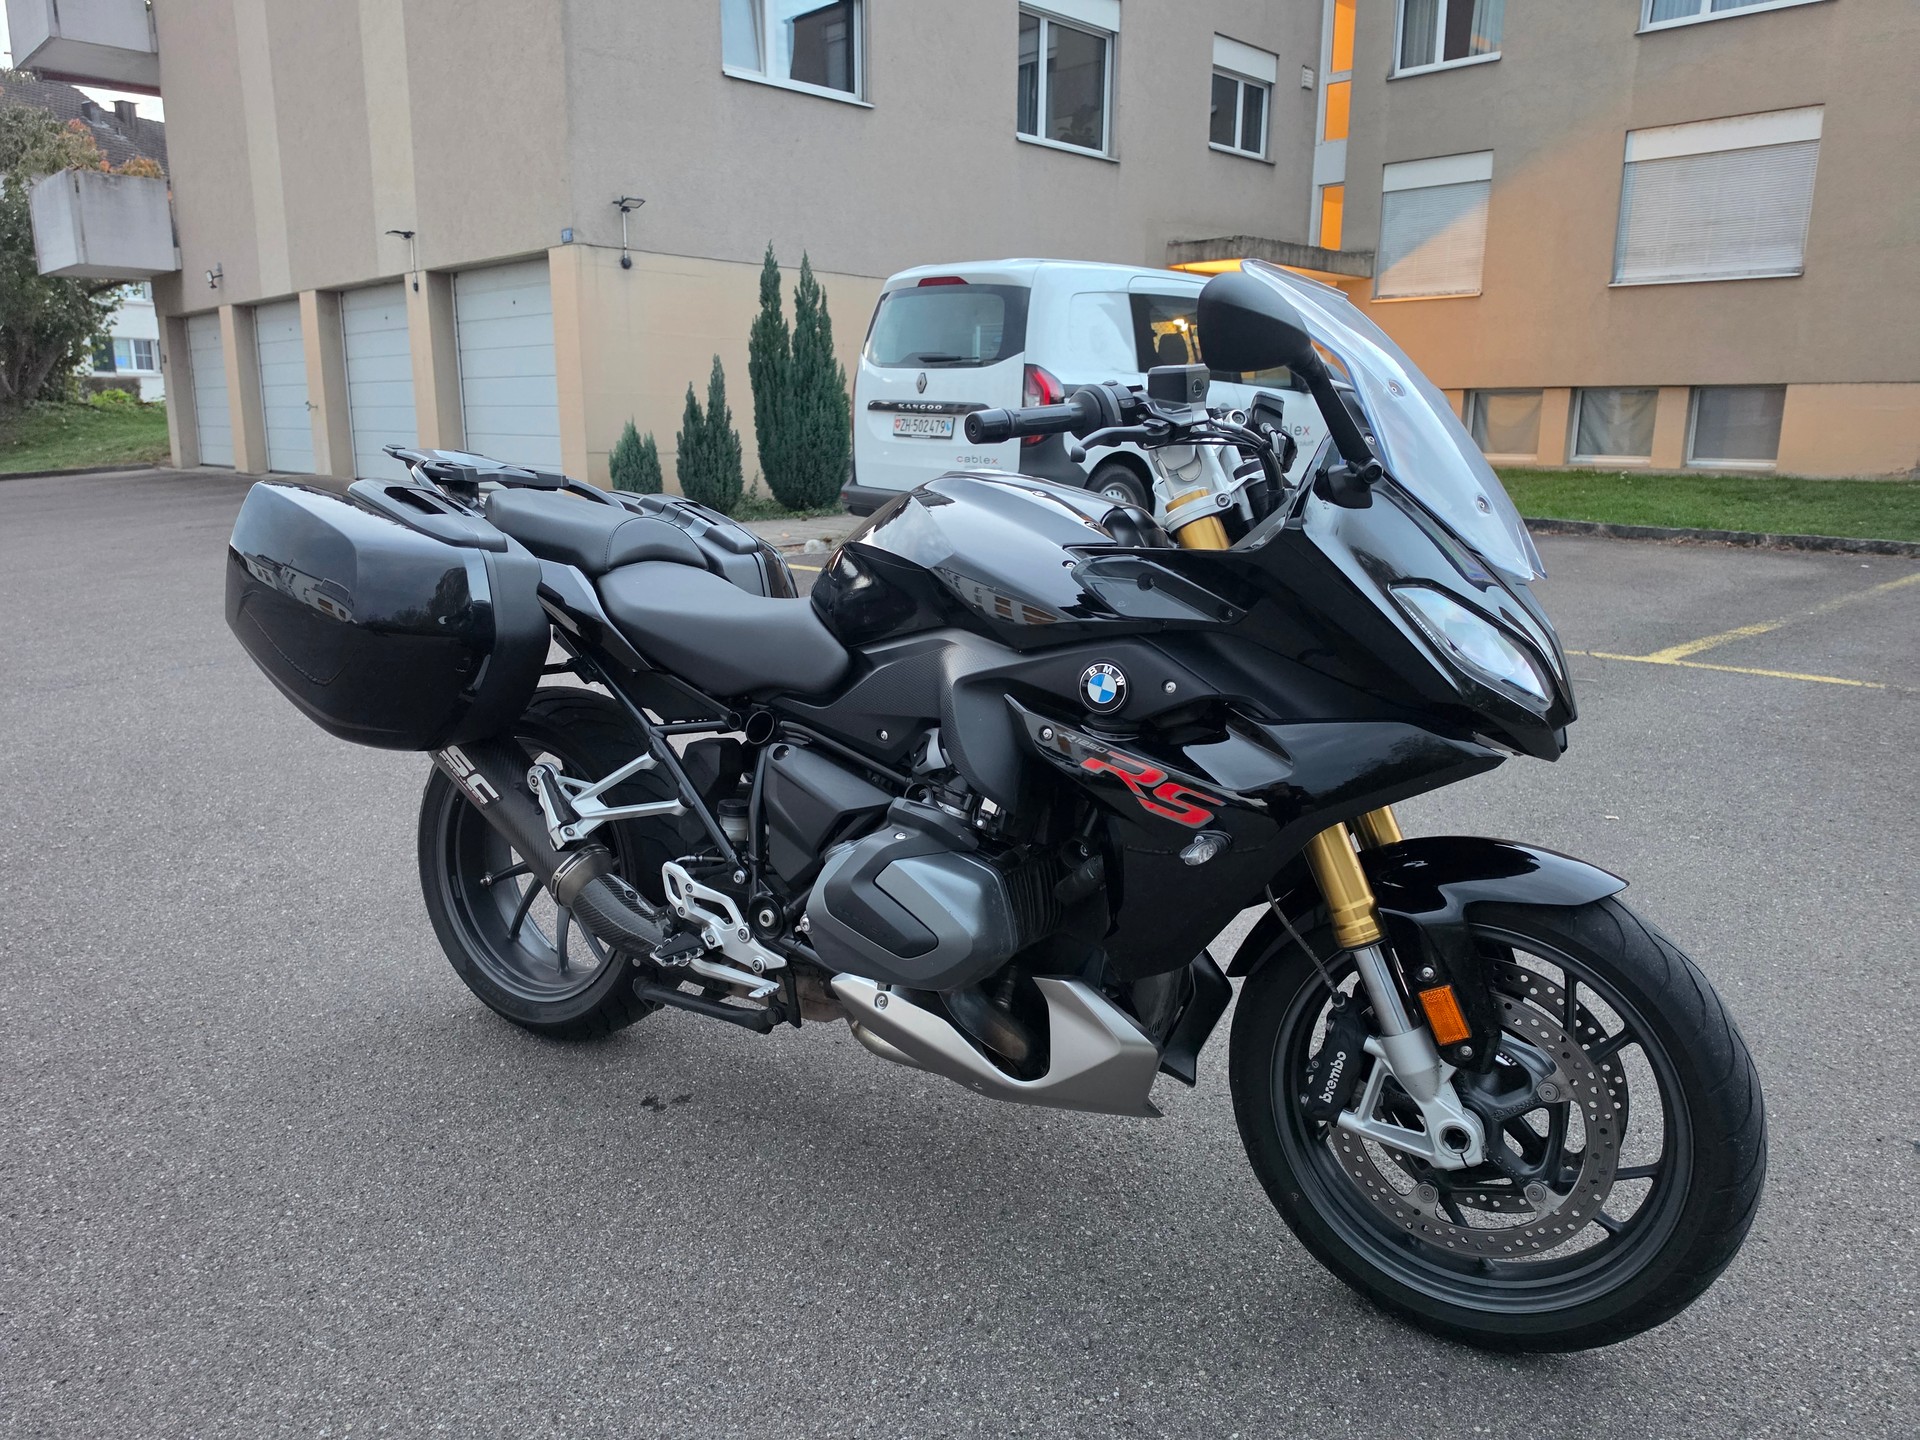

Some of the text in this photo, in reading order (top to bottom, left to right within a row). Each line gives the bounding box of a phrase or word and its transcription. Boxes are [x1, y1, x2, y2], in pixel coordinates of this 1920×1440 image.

[956, 455, 998, 465] cablex
[1088, 665, 1125, 686] BMW
[441, 745, 499, 804] SC
[1080, 751, 1227, 829] RS
[1319, 1051, 1347, 1104] brembo
